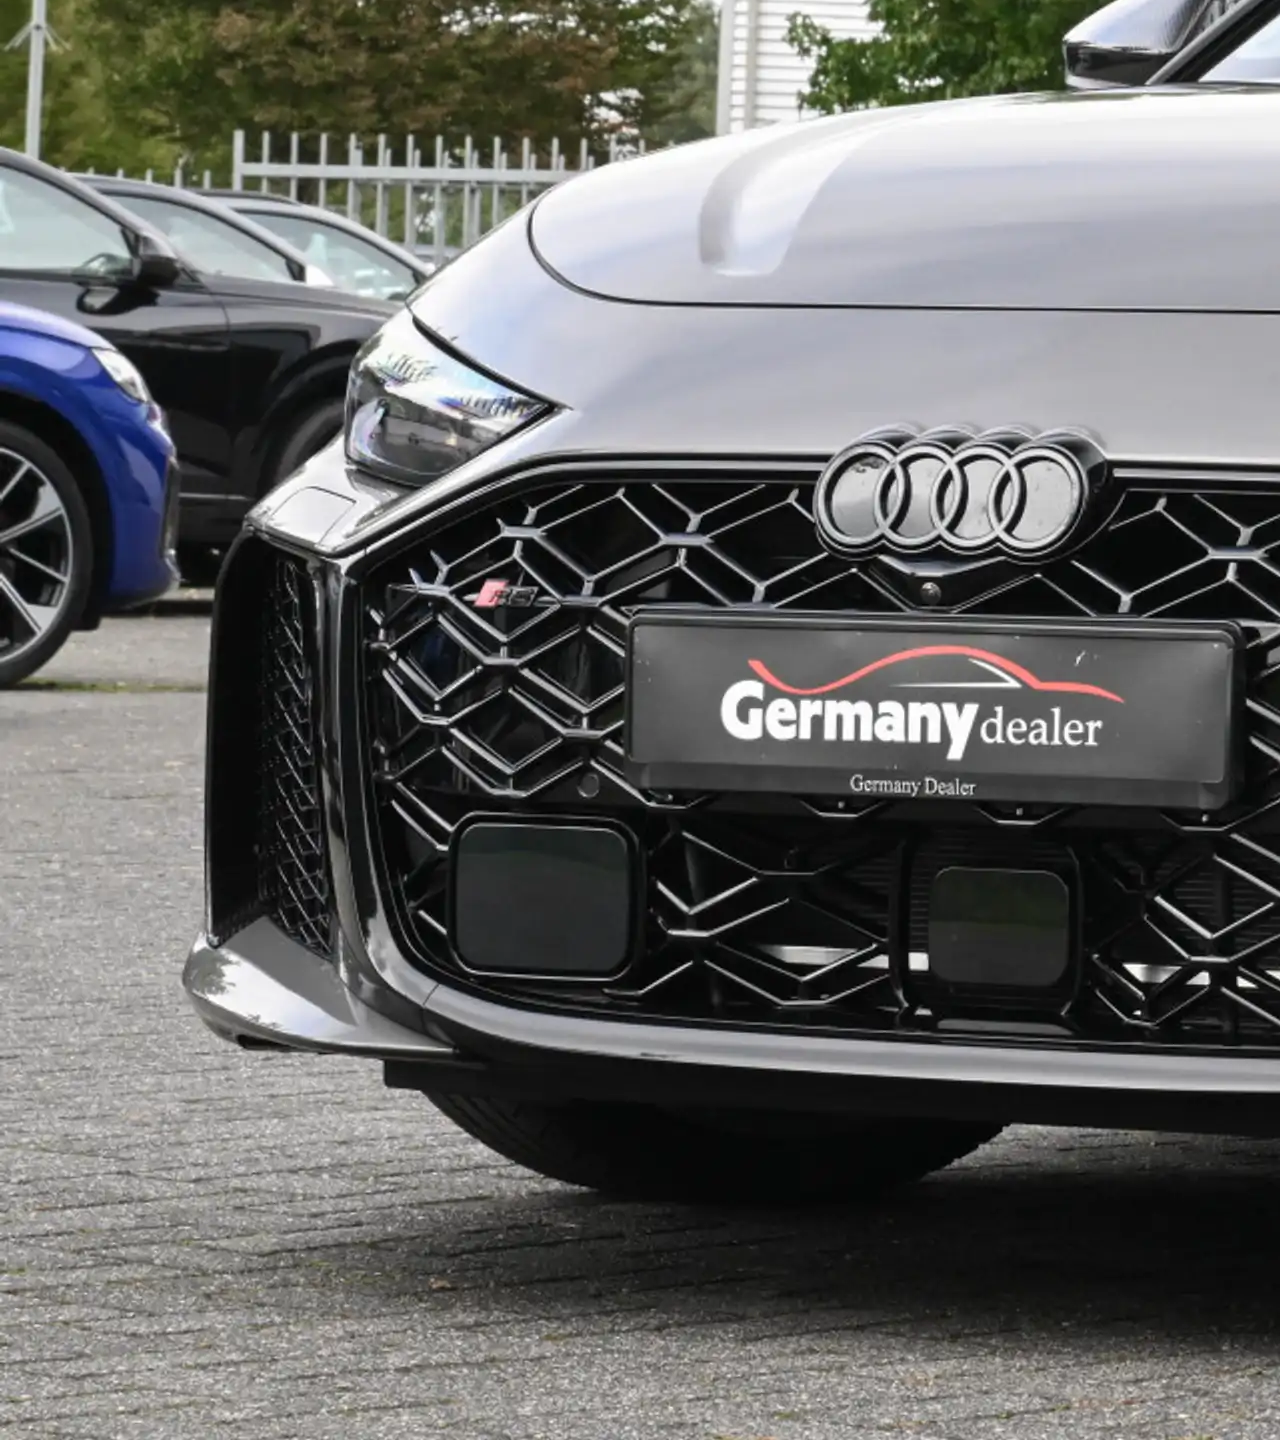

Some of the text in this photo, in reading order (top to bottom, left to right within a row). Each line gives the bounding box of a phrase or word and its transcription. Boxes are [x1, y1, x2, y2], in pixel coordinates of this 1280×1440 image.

[719, 679, 1104, 761] Germany dealer
[849, 773, 977, 797] Germany Dealer
